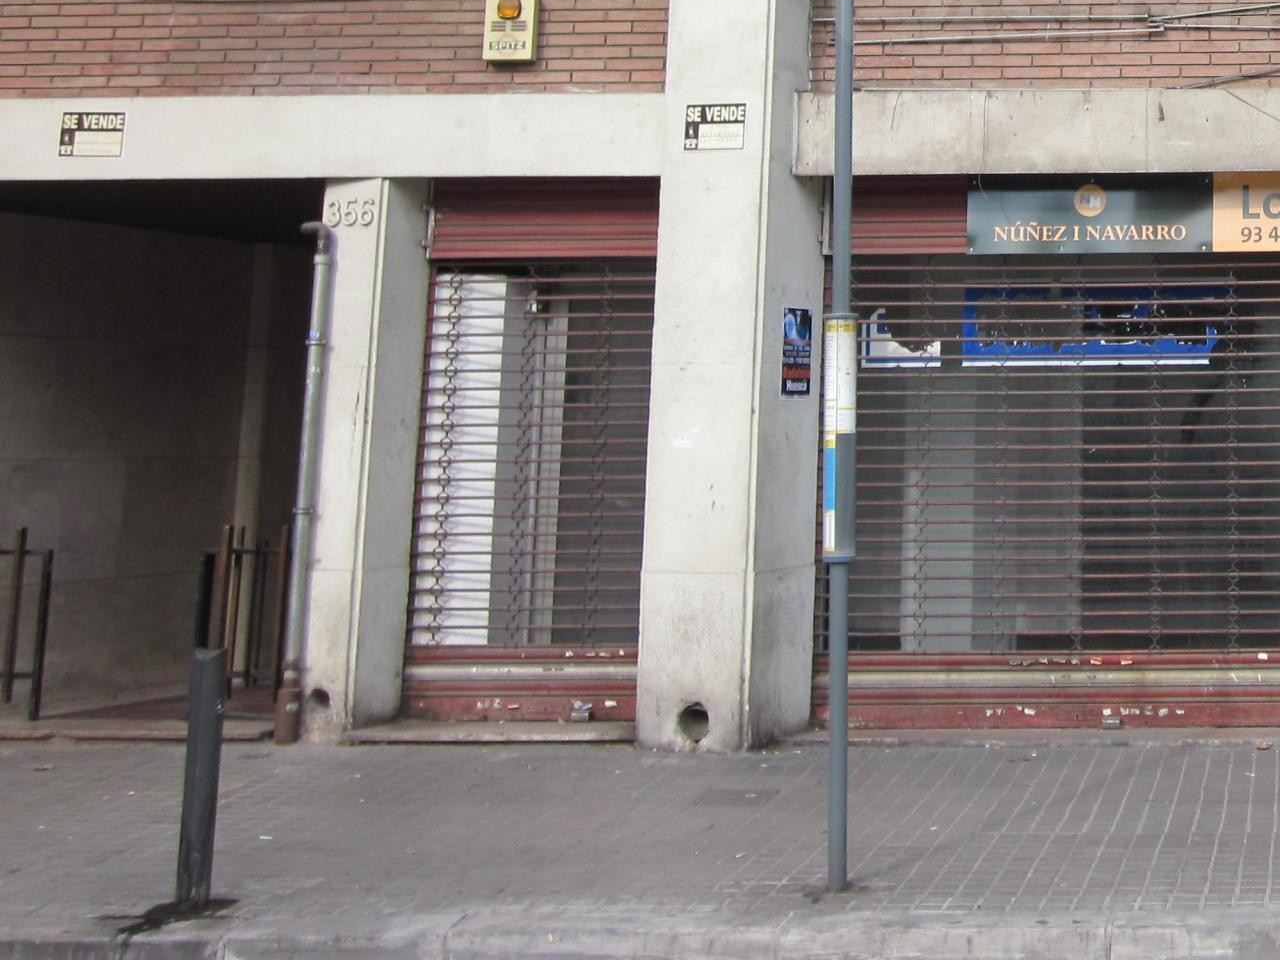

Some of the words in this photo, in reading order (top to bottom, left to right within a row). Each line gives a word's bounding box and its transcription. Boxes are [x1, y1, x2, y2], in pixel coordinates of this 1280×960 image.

[63, 114, 80, 129] SE
[82, 114, 124, 129] VENDE
[687, 106, 702, 122] SE
[705, 105, 745, 122] VENDE
[327, 198, 376, 229] 356
[993, 220, 1068, 241] NÚÑEZ
[1072, 225, 1080, 241] I
[1087, 224, 1187, 241] NAVARRO
[1240, 226, 1263, 243] 93
